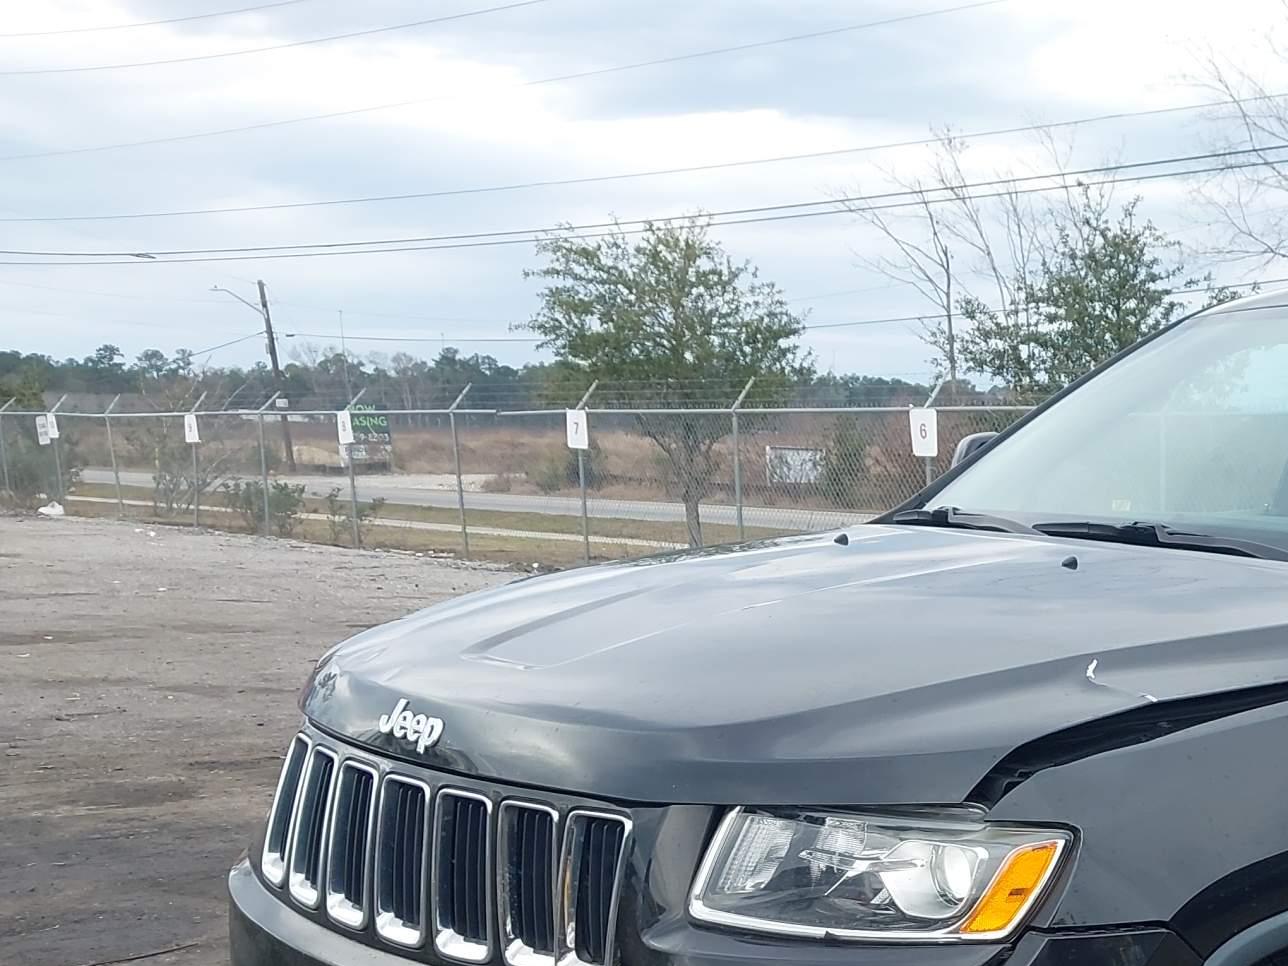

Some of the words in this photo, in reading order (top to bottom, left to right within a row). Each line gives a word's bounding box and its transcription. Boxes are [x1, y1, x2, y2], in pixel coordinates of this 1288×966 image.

[353, 416, 387, 426] ASING
[919, 423, 928, 440] 6
[378, 698, 444, 755] Jeep
